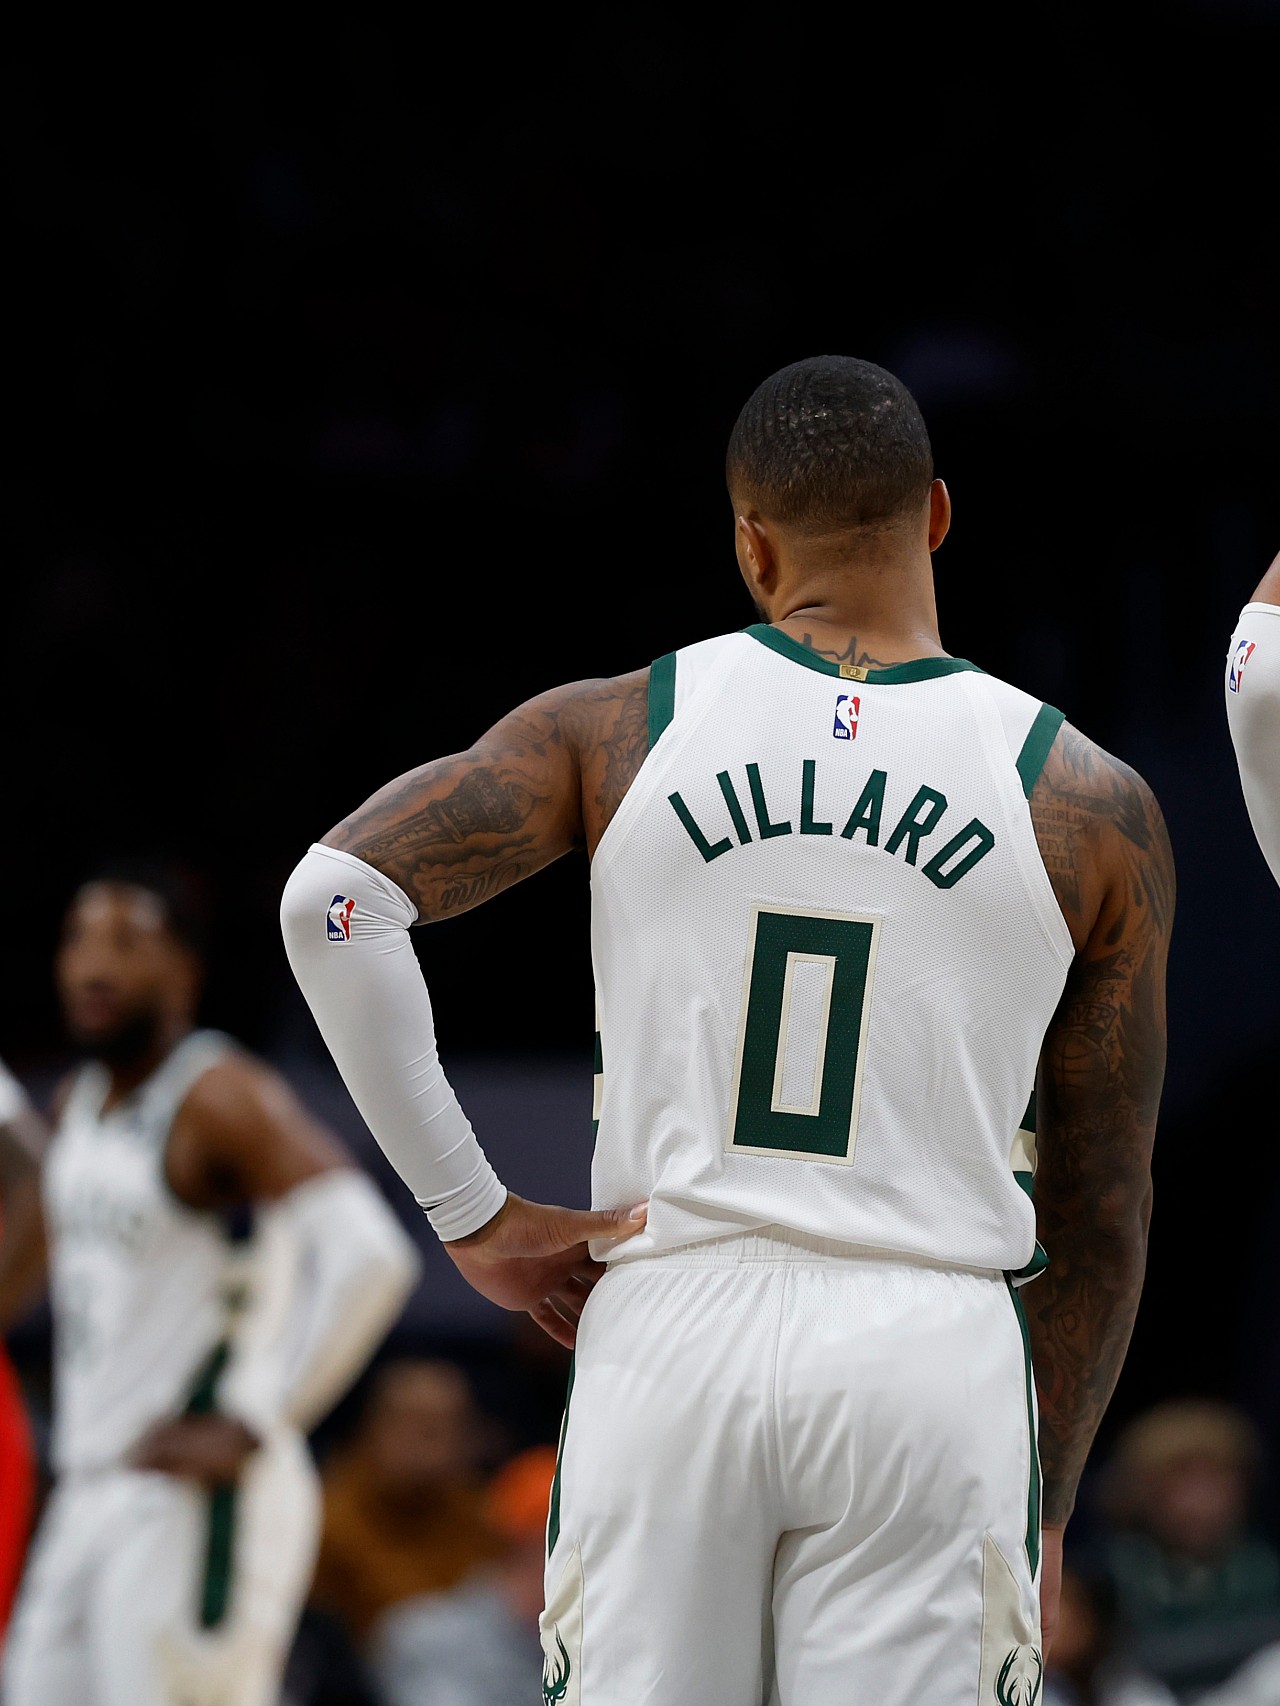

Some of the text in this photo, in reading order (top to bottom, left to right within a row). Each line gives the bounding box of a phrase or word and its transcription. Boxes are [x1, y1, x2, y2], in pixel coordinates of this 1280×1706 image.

[835, 728, 848, 738] NBA
[667, 759, 996, 890] LILLARD
[329, 931, 343, 939] NBA
[725, 903, 884, 1167] 0
